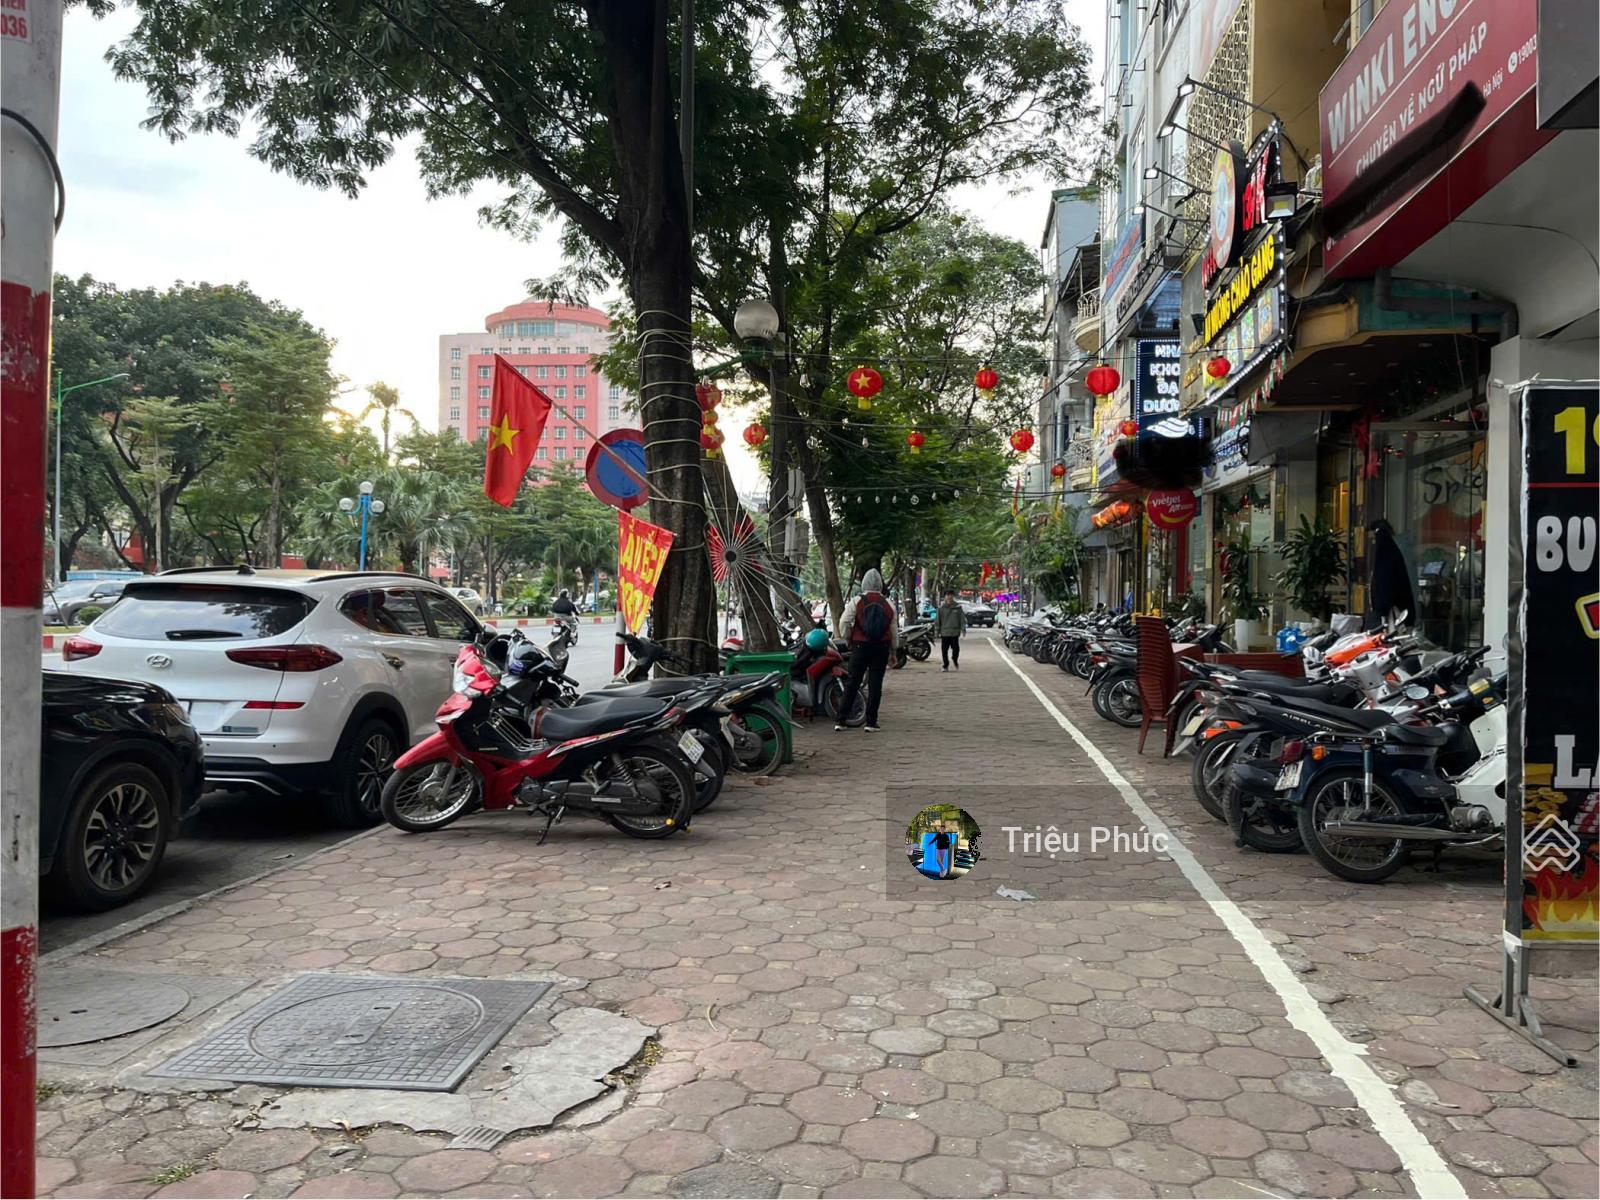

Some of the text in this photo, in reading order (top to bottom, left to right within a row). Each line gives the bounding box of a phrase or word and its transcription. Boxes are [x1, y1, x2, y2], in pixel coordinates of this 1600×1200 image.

[1328, 33, 1393, 154] WINKI
[1356, 21, 1487, 178] CHUYÊN VỀ NGỮ PHÁP
[1492, 67, 1503, 90] Nội
[1251, 234, 1274, 289] GANG
[1554, 407, 1599, 475] 1
[1536, 516, 1597, 572] BU
[1554, 735, 1599, 788] L
